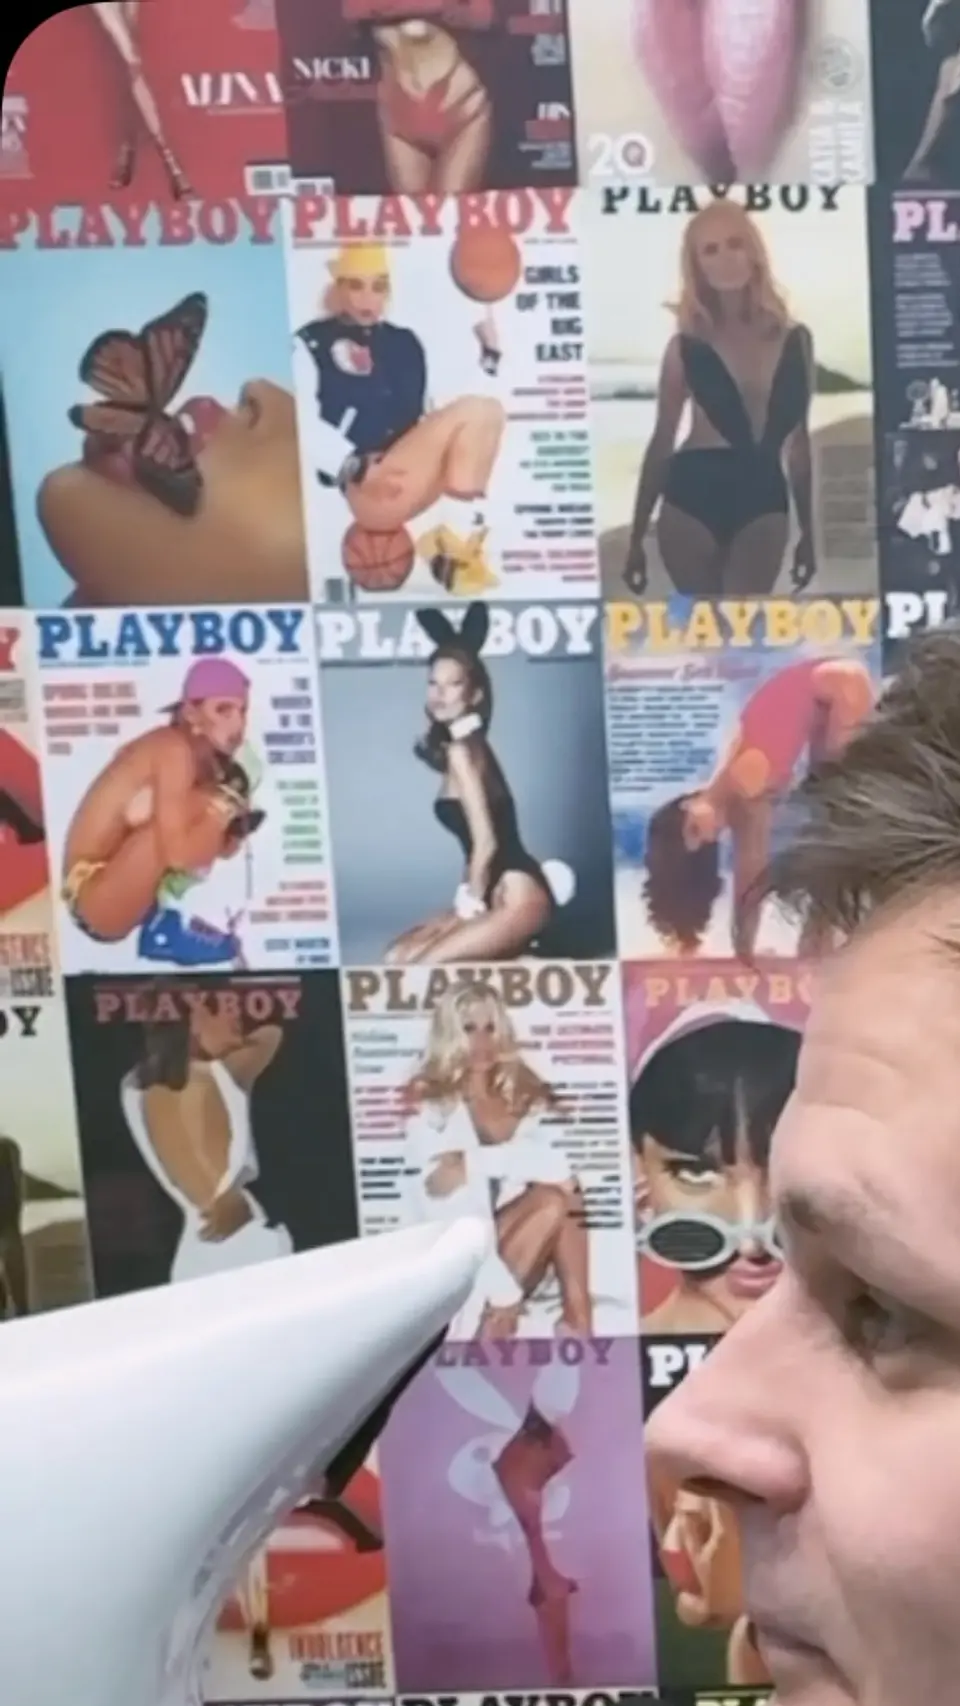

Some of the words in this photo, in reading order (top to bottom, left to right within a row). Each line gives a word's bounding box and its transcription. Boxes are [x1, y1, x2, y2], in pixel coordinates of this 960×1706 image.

[0, 199, 280, 249] PLAYBOY
[525, 264, 580, 285] GIRLS
[535, 342, 585, 363] EAST
[36, 609, 304, 659] PLAYBOY
[604, 598, 881, 652] PLAYBOY
